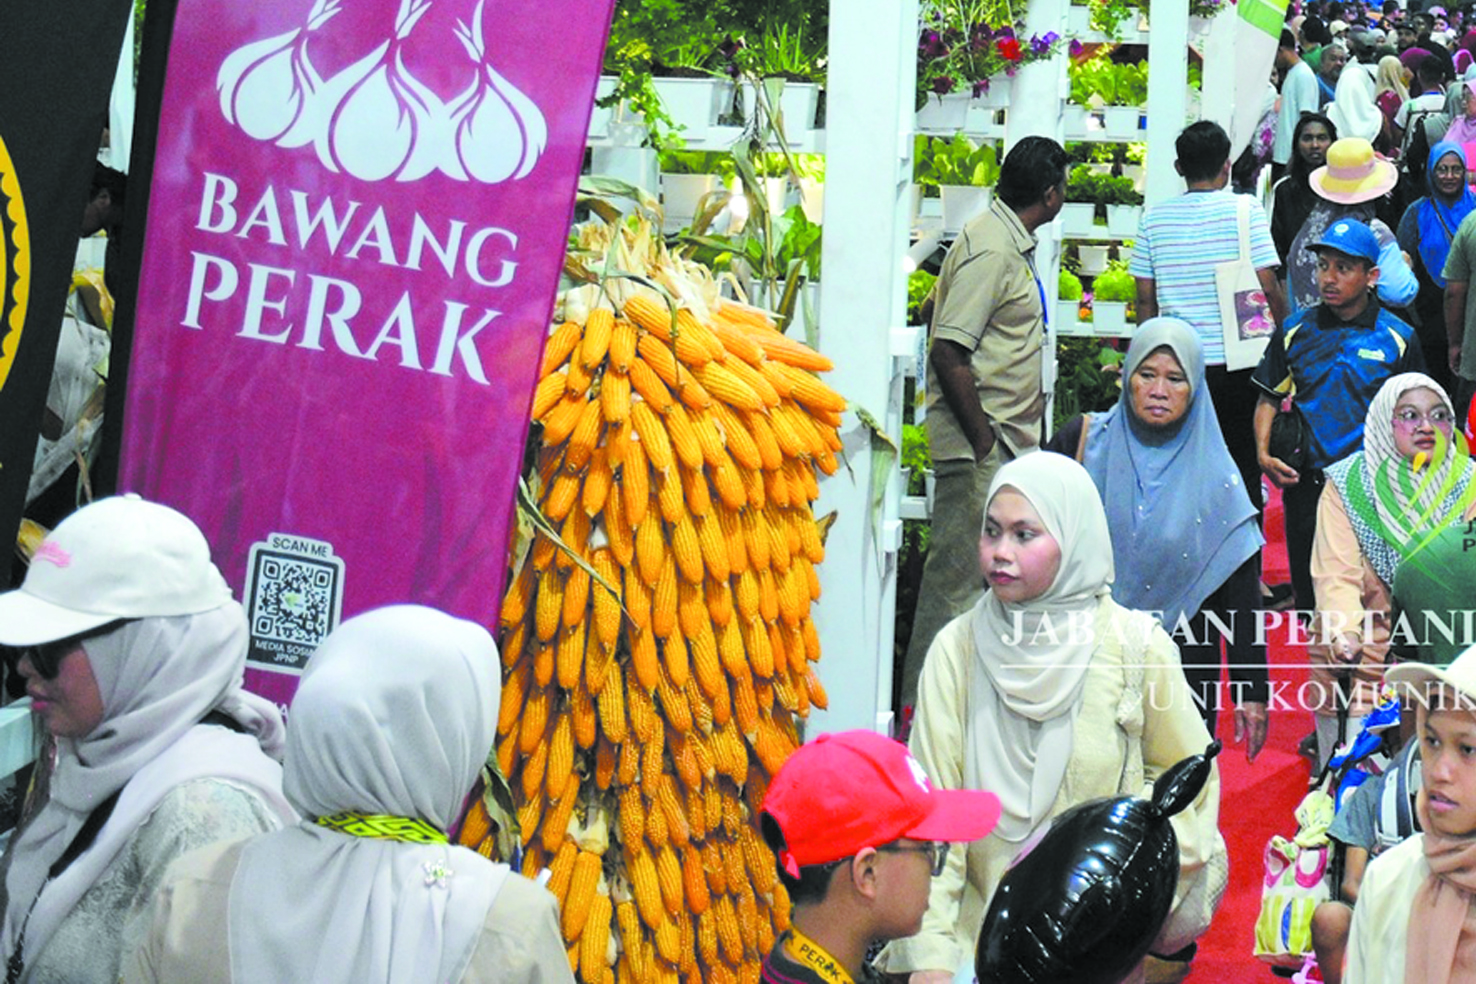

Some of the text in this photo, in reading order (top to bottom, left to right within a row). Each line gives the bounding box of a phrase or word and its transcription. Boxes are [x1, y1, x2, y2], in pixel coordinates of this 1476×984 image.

[195, 172, 520, 288] BAWANG
[179, 250, 504, 386] PERAK
[271, 537, 329, 558] SCAN ME
[255, 640, 285, 653] MEDIA
